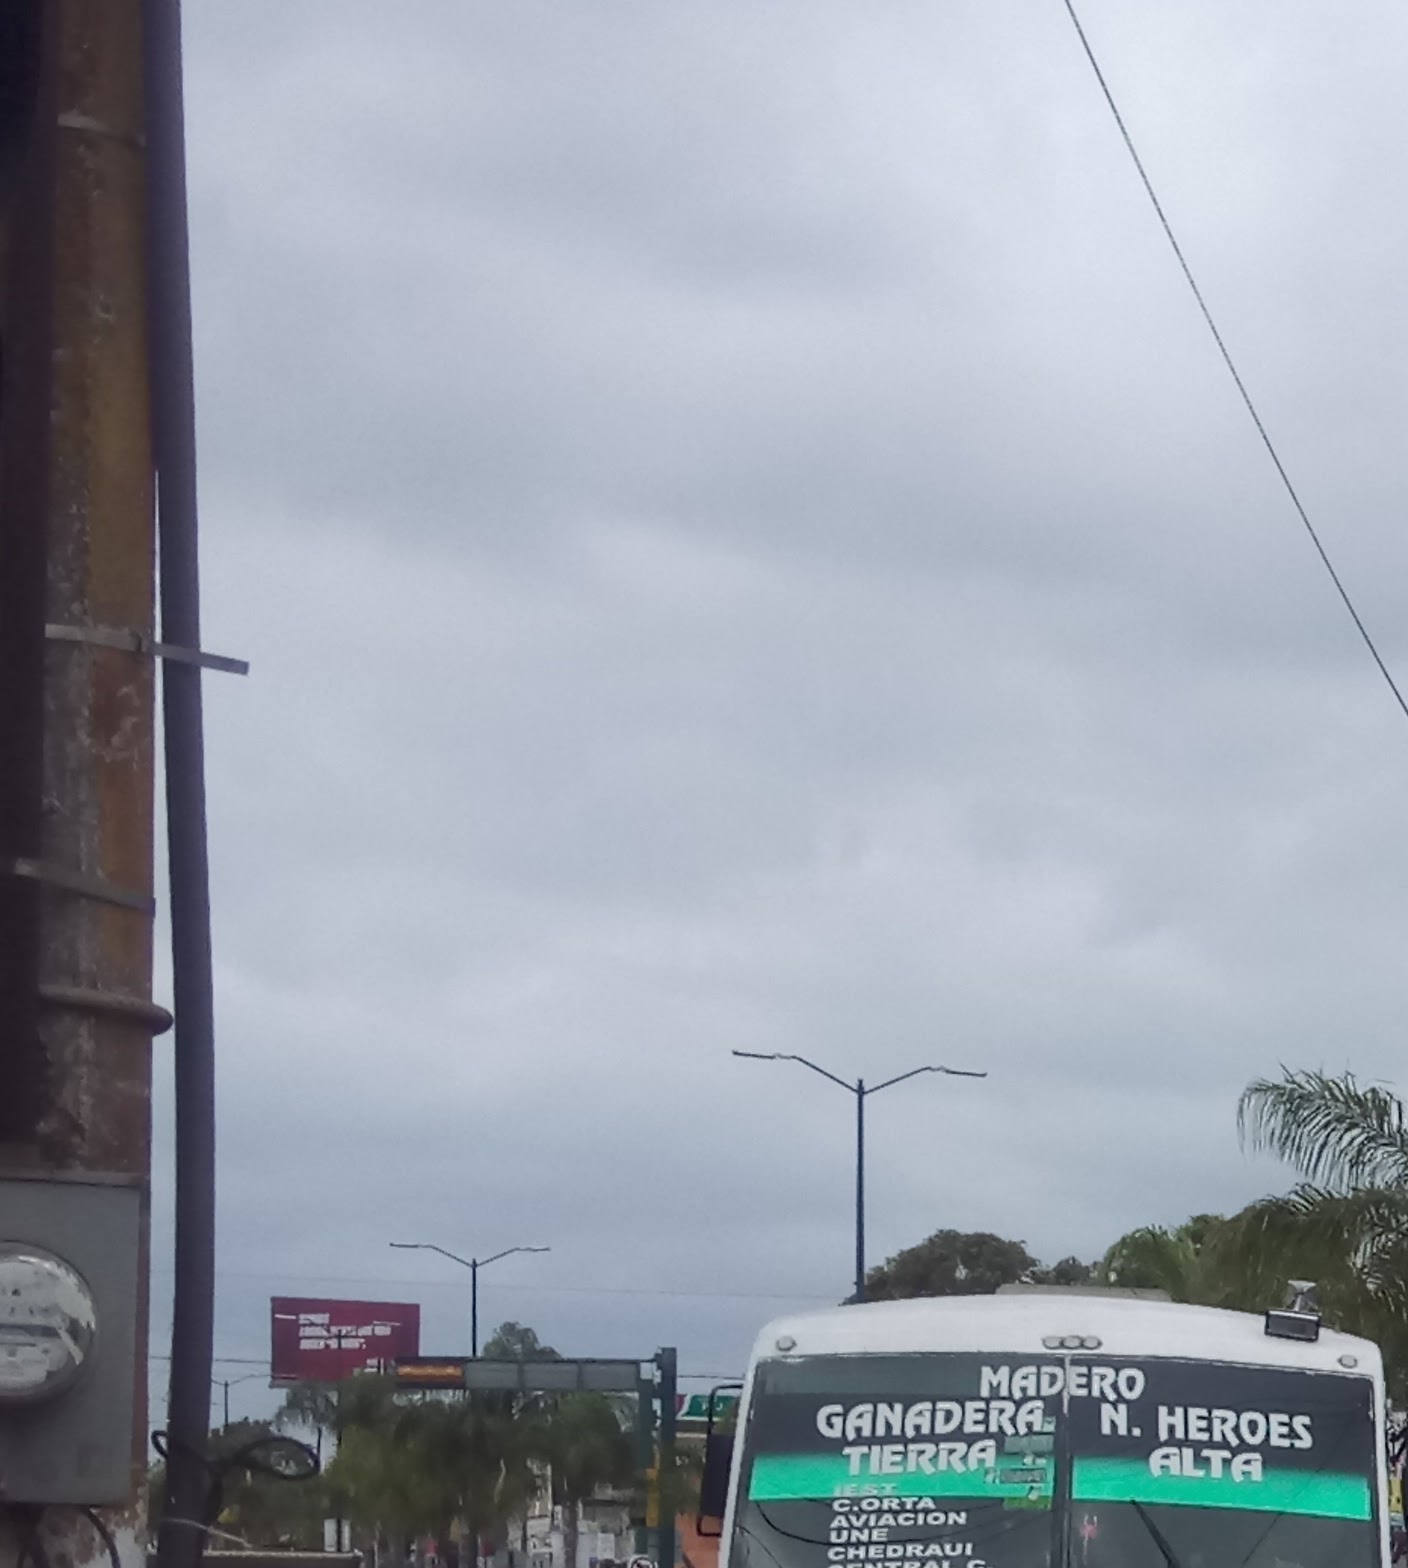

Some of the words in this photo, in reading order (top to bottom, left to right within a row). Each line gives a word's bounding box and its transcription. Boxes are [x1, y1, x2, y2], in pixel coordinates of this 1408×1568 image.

[979, 1365, 1146, 1402] MADERO
[816, 1400, 1045, 1441] GANADERA
[1100, 1402, 1142, 1437] N.
[1157, 1404, 1314, 1450] HEROES
[842, 1439, 997, 1477] TIERRA
[1148, 1446, 1265, 1484] ALTA
[832, 1496, 937, 1512] C.ORTA
[829, 1511, 968, 1528] AVIACION
[829, 1528, 889, 1543] UNE
[827, 1542, 974, 1561] CHEDRAUI
